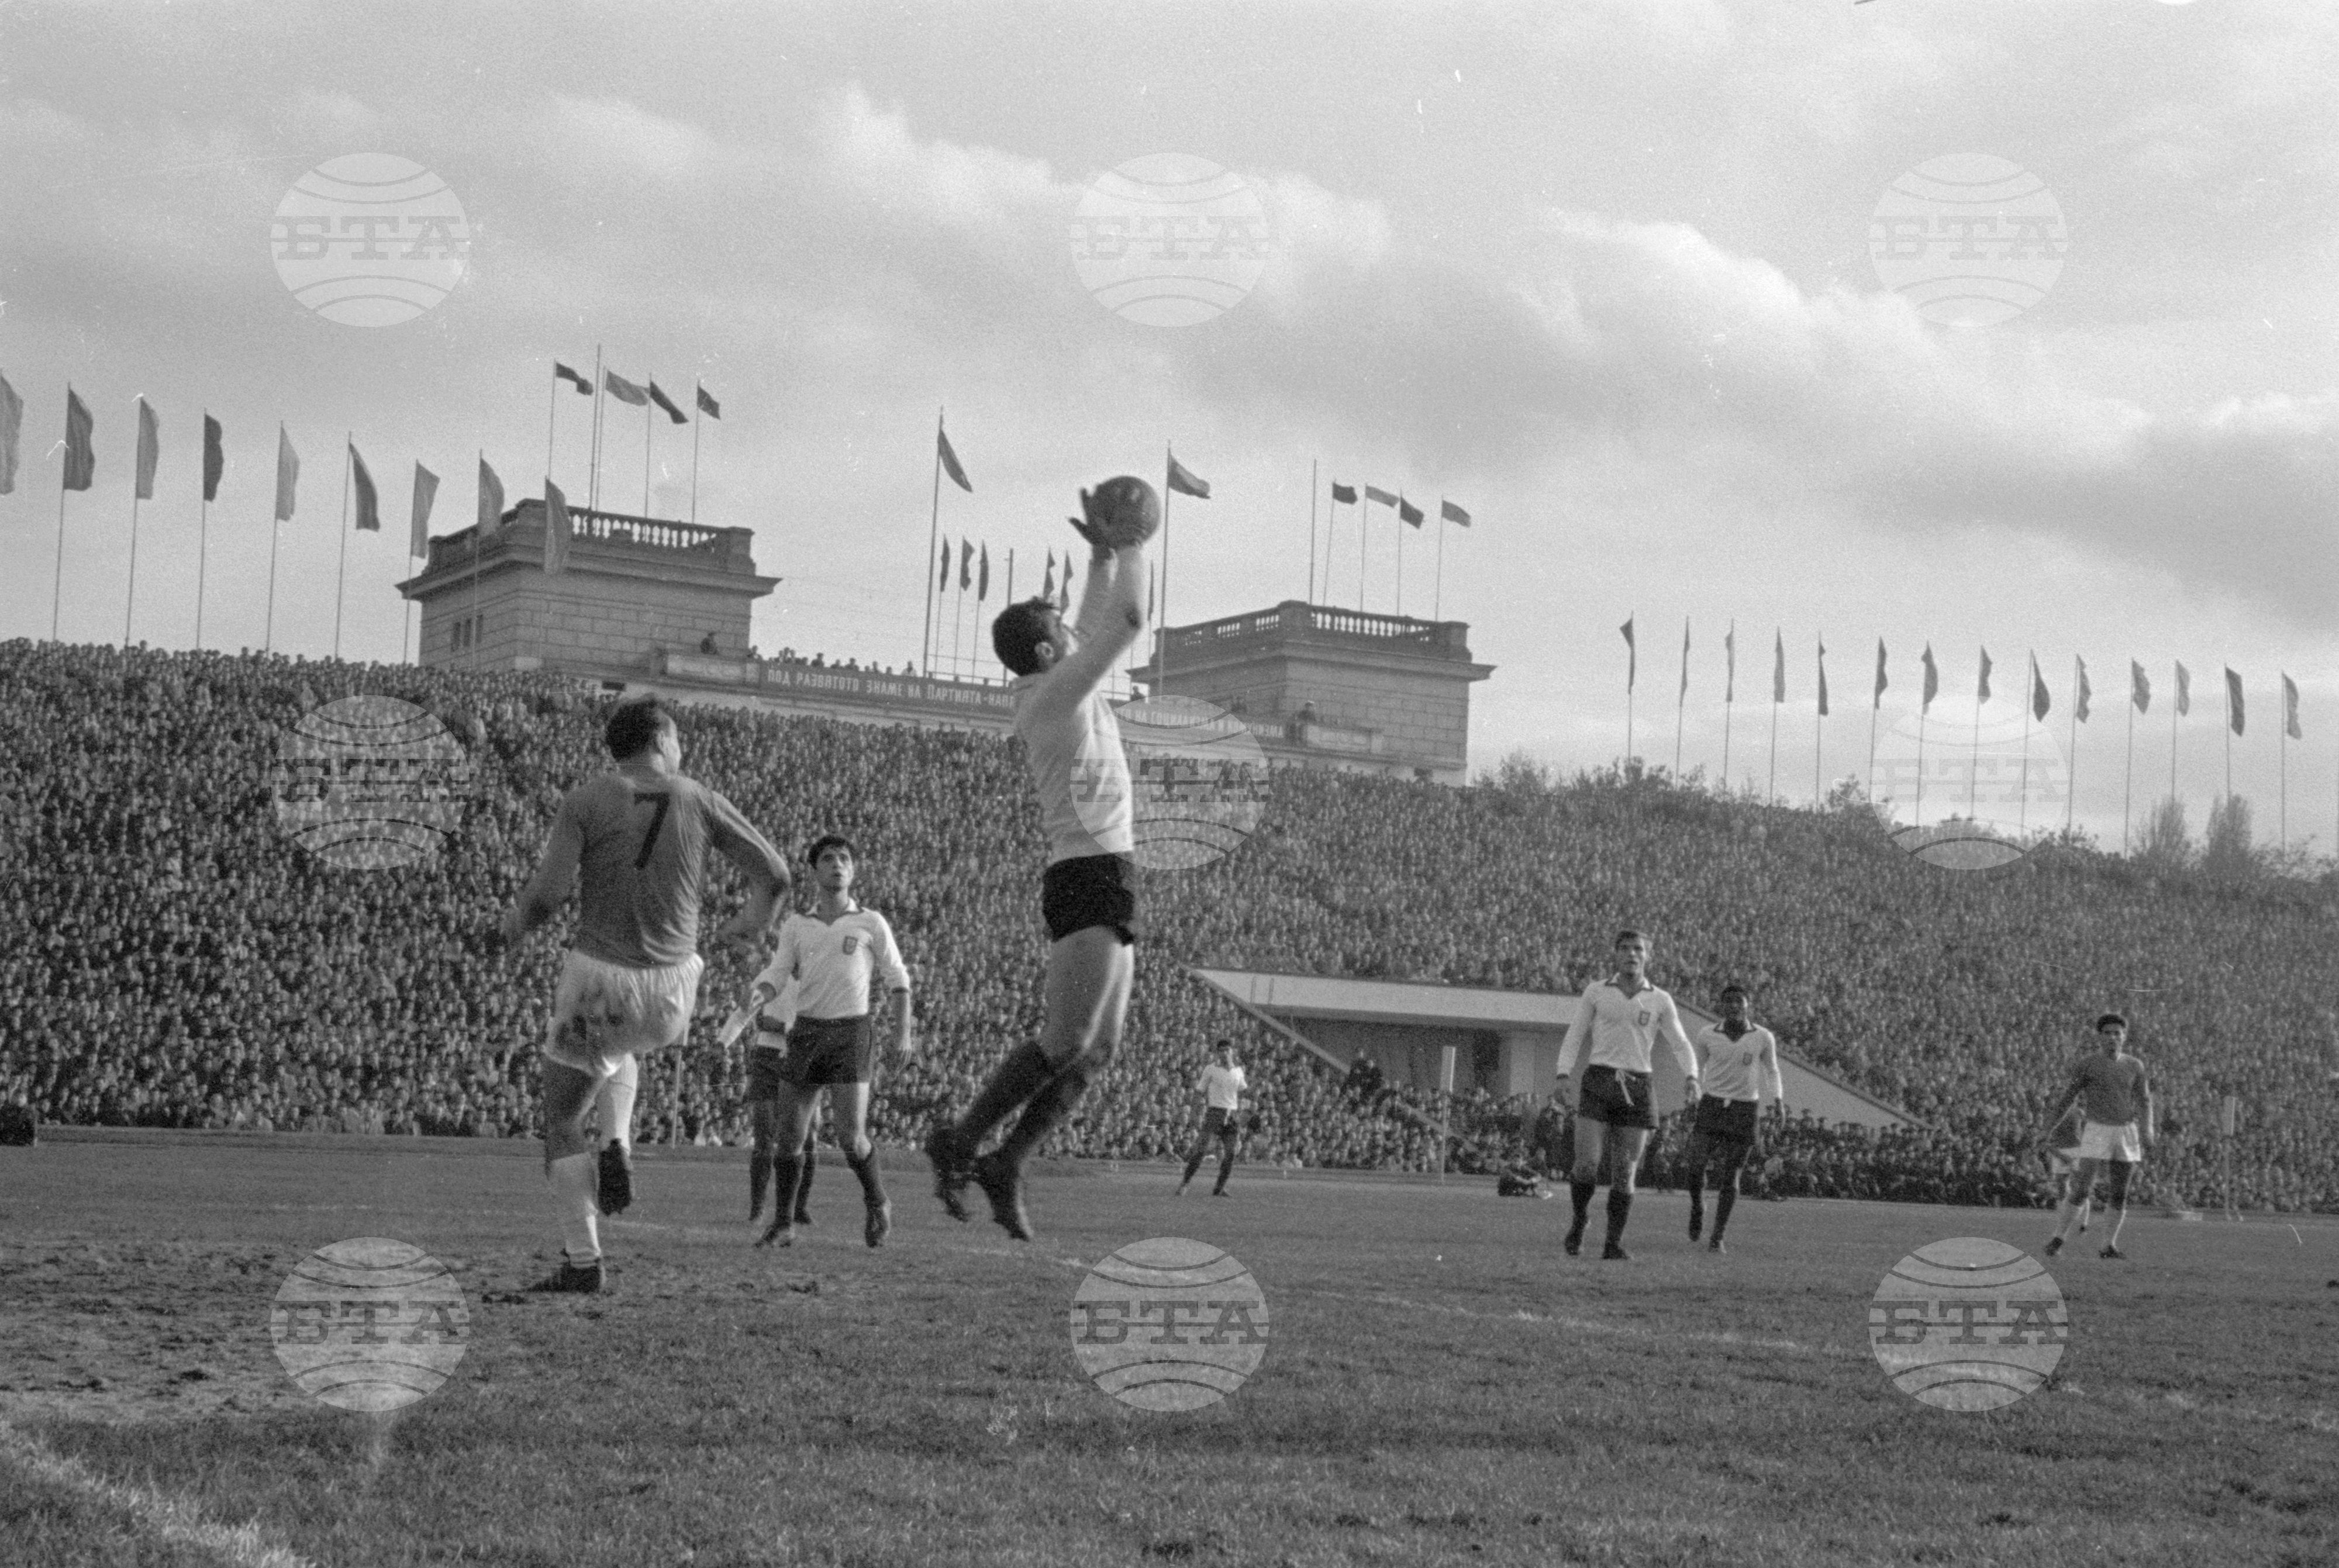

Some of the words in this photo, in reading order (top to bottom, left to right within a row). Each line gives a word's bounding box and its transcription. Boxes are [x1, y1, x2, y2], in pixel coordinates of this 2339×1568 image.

[768, 669, 791, 687] ПОД
[866, 679, 903, 696] ЗНАМЕ
[908, 683, 922, 699] НА
[634, 792, 670, 870] 7
